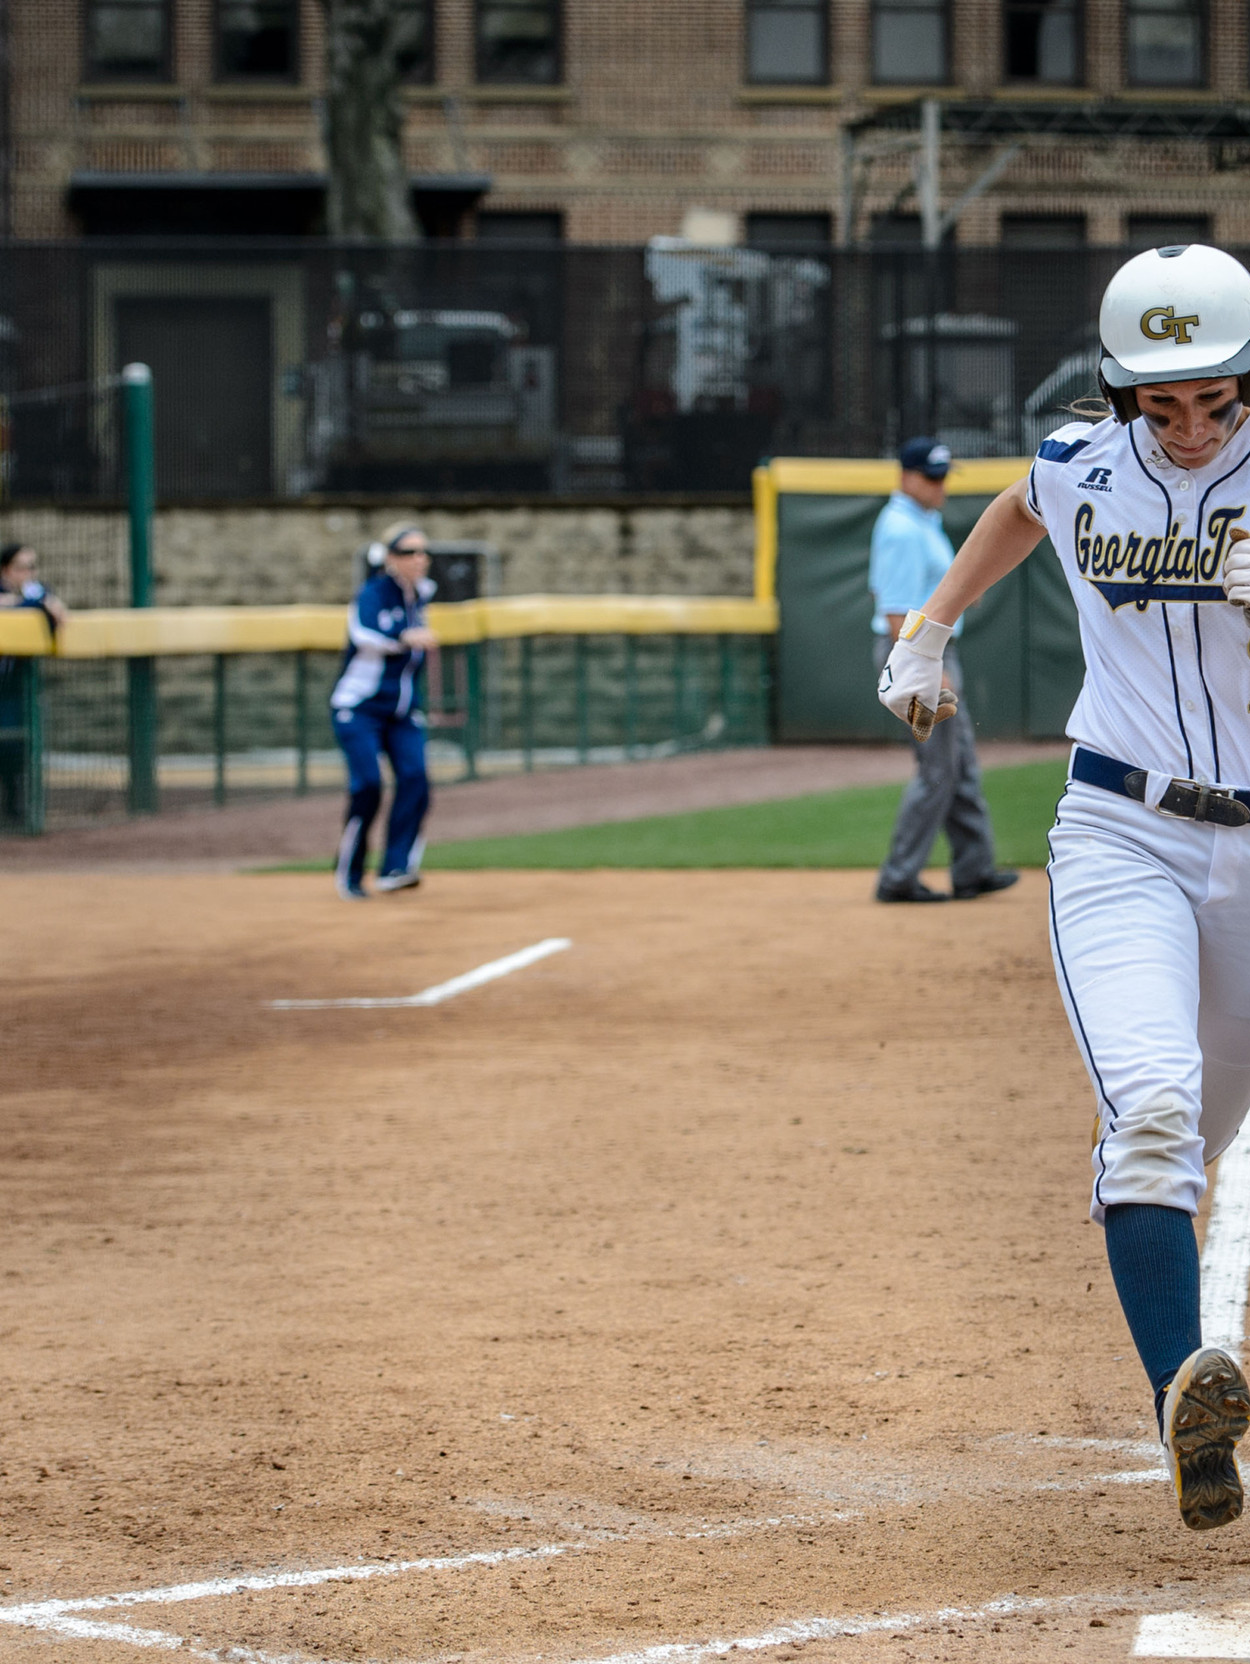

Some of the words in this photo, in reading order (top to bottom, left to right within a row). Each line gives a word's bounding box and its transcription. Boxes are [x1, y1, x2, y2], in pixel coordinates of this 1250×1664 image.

[1141, 306, 1199, 345] GT
[1077, 482, 1113, 492] RUSSELL
[1075, 502, 1198, 614] Georgia
